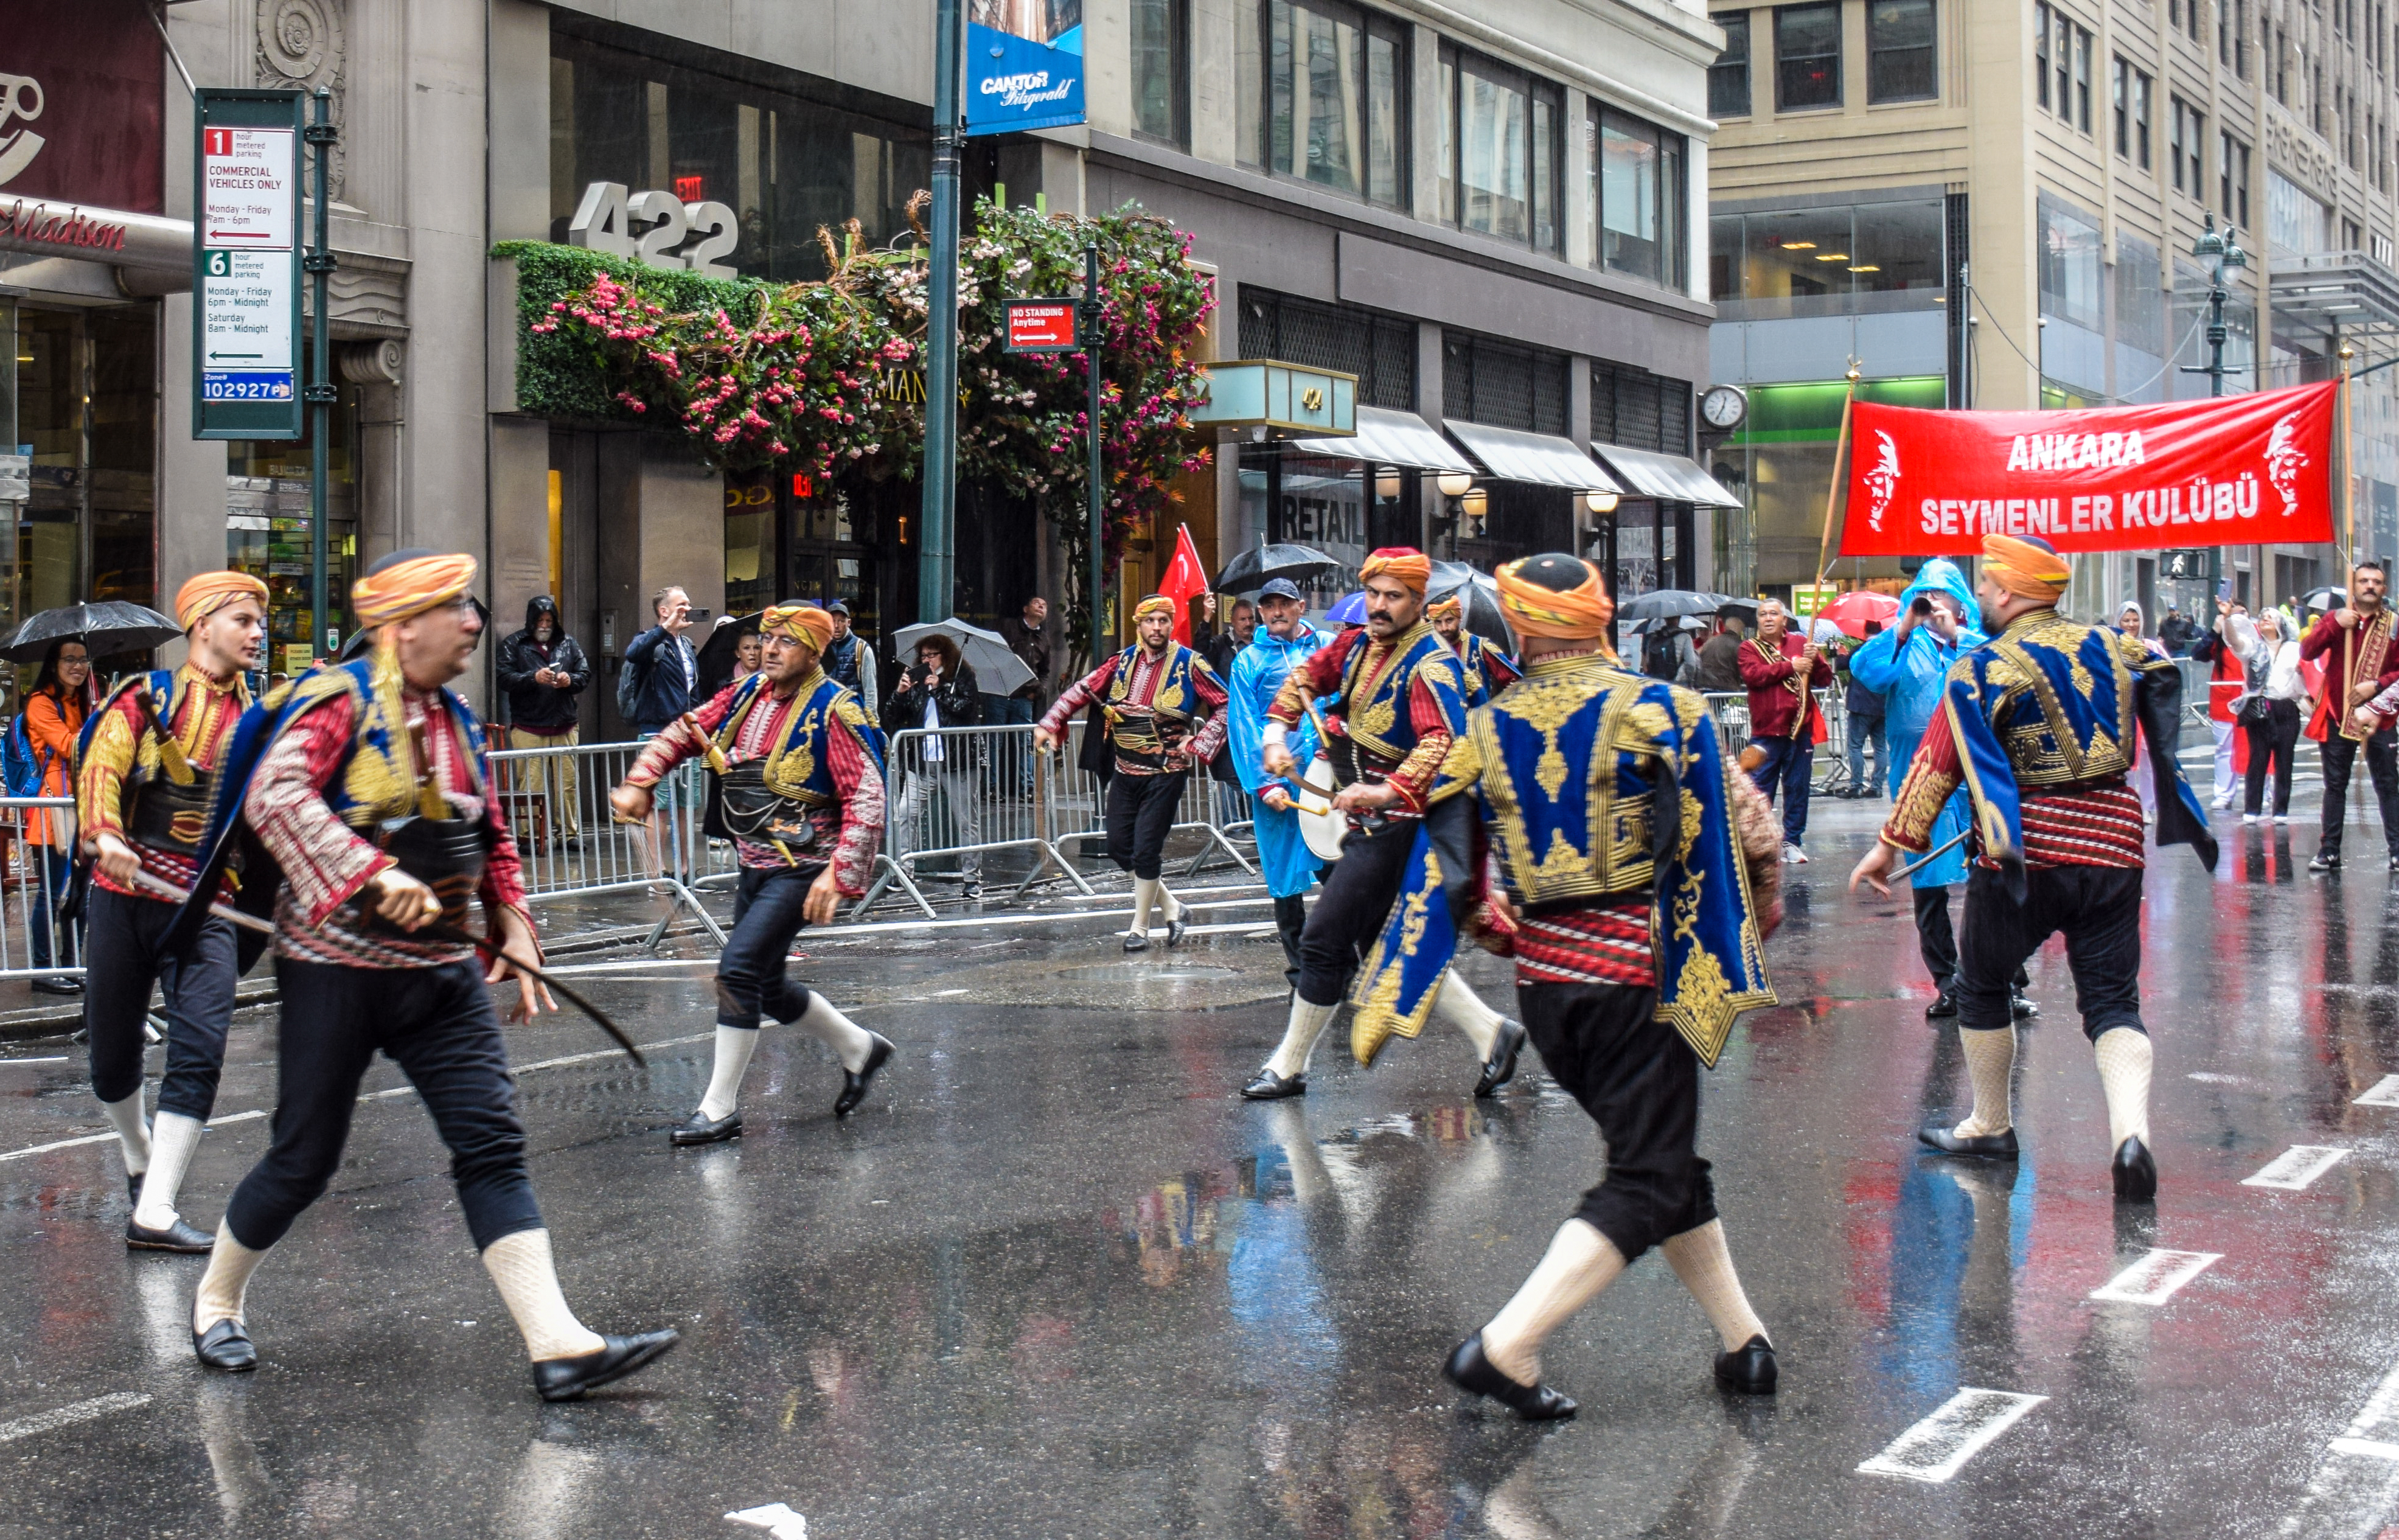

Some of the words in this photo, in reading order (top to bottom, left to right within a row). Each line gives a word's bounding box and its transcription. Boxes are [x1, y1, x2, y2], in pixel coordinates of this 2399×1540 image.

[981, 72, 1048, 94] CANTOR
[1000, 79, 1076, 111] Fitzgerald
[214, 131, 223, 154] 1
[209, 166, 271, 176] COMMERCIAL
[209, 179, 254, 189] VEHICLES
[257, 180, 281, 189] ONLY
[677, 176, 702, 201] EXIT
[209, 204, 240, 214] Monday
[248, 206, 271, 216] Friday
[0, 199, 126, 251] Madison
[232, 216, 250, 226] 6pm
[570, 182, 739, 280] 422
[211, 253, 226, 275] 6
[207, 287, 239, 296] Monday
[247, 288, 272, 298] Friday
[208, 299, 226, 308] 6pm
[235, 298, 269, 308] Midnight
[208, 313, 245, 323] Saturday
[1025, 308, 1064, 316] STANDING
[234, 324, 268, 334] Midnight
[1013, 318, 1046, 327] Anytime
[204, 383, 270, 397] 102927
[2007, 431, 2145, 472] ANKARA
[1921, 495, 2114, 536] SEYMENLER
[2122, 472, 2259, 528] KULÜBÜ
[1281, 495, 1365, 545] RETAIL
